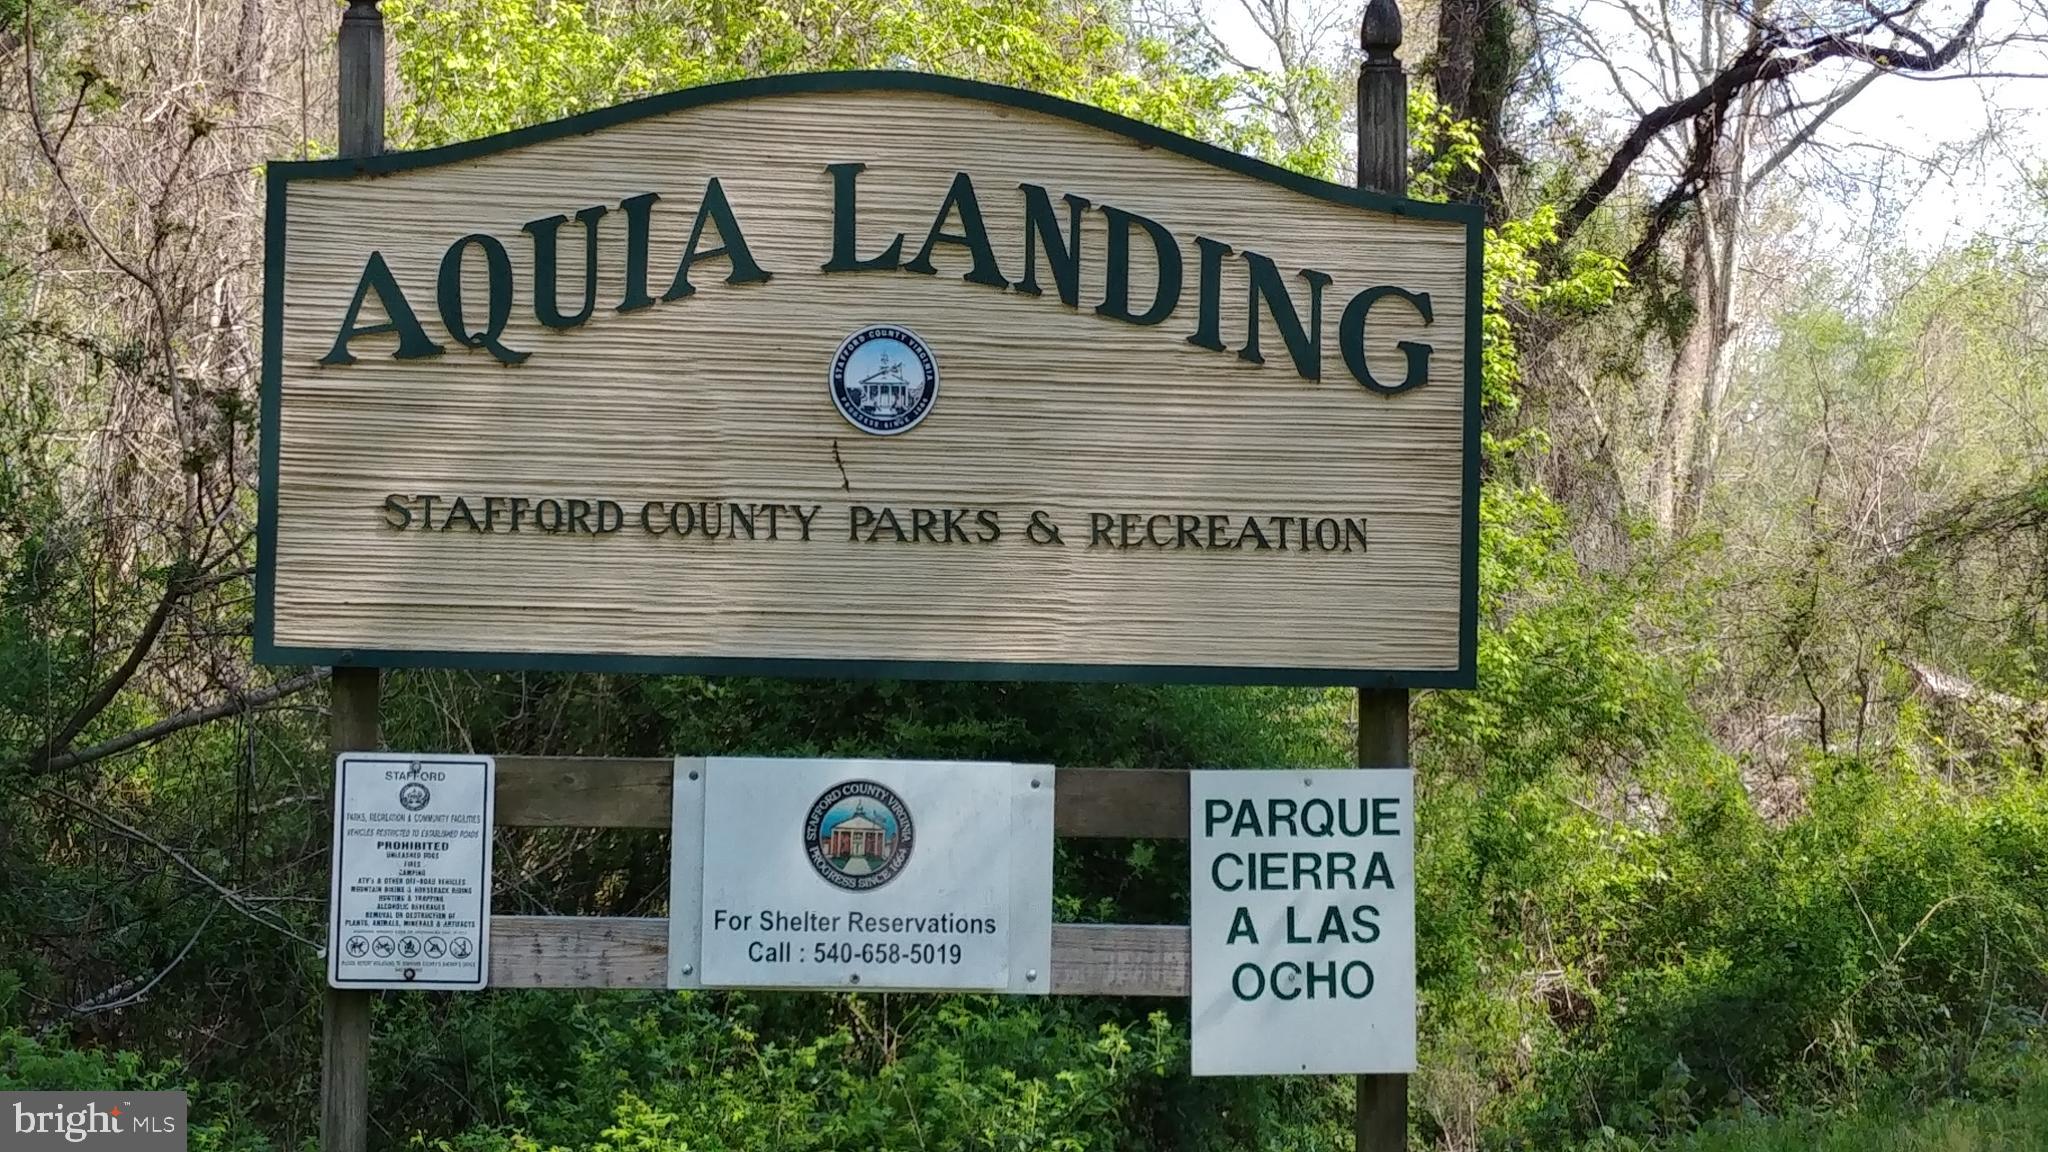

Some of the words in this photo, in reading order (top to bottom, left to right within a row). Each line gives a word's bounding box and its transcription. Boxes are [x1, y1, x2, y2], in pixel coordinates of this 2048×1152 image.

[318, 176, 775, 366] AQUIA
[822, 161, 1435, 396] LANDING
[834, 335, 865, 380] STAFFORD
[868, 329, 907, 341] COUNTY
[908, 339, 934, 381] VIRGINIA
[384, 492, 624, 535] STAFFORD
[639, 500, 822, 543] COUNTY
[848, 506, 1002, 545] PARKS
[1025, 509, 1066, 547] &
[1087, 510, 1369, 554] RECREATION
[385, 770, 446, 782] STAFFORD
[806, 789, 842, 841] STAFFORD
[841, 783, 889, 800] COUNTY
[888, 795, 912, 843] VIRGINIA
[1205, 798, 1401, 838] PARQUE
[377, 841, 449, 851] PROHIBITED
[384, 877, 403, 885] OTHER
[438, 878, 467, 886] VEHICLES
[809, 845, 857, 888] PROGRESS
[857, 872, 892, 889] SINCE
[1211, 851, 1396, 892] CIERRA
[414, 886, 450, 894] HORSEBACK
[365, 911, 394, 919] REMOVAL
[405, 911, 447, 919] DESTRUCTION
[411, 903, 446, 911] BEVERAGES
[713, 909, 752, 931] For
[759, 910, 841, 932] Shelter
[848, 912, 997, 934] Reservations
[403, 919, 434, 927] MINERALS
[442, 920, 476, 928] ARTIFACTS
[1226, 906, 1260, 945] A
[1286, 904, 1381, 944] LAS
[748, 941, 791, 963] Call
[813, 942, 962, 965] 540-658-5019
[1232, 959, 1375, 1002] OCHO
